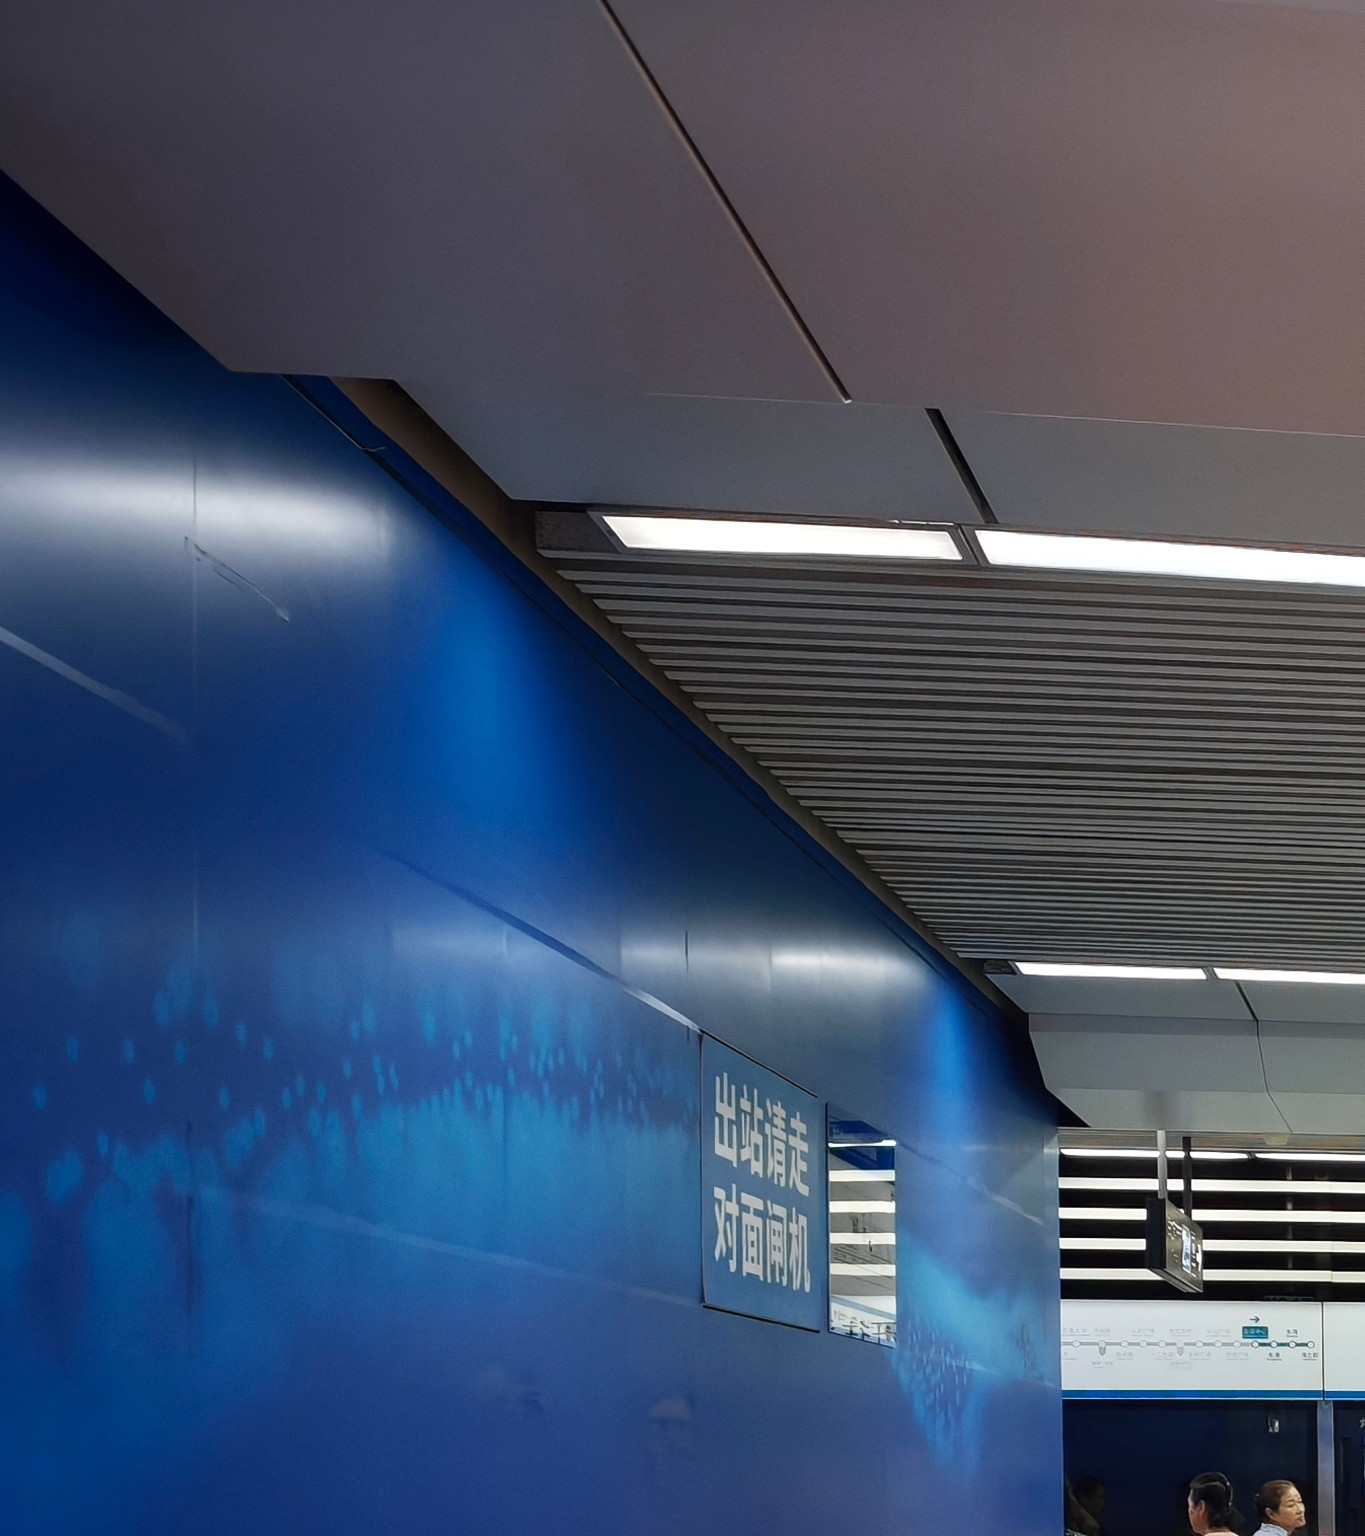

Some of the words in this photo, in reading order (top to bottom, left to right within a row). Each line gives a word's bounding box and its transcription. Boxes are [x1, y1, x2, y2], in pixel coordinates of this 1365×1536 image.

[714, 1072, 810, 1197] 出站请走
[714, 1184, 811, 1293] 对面闸机
